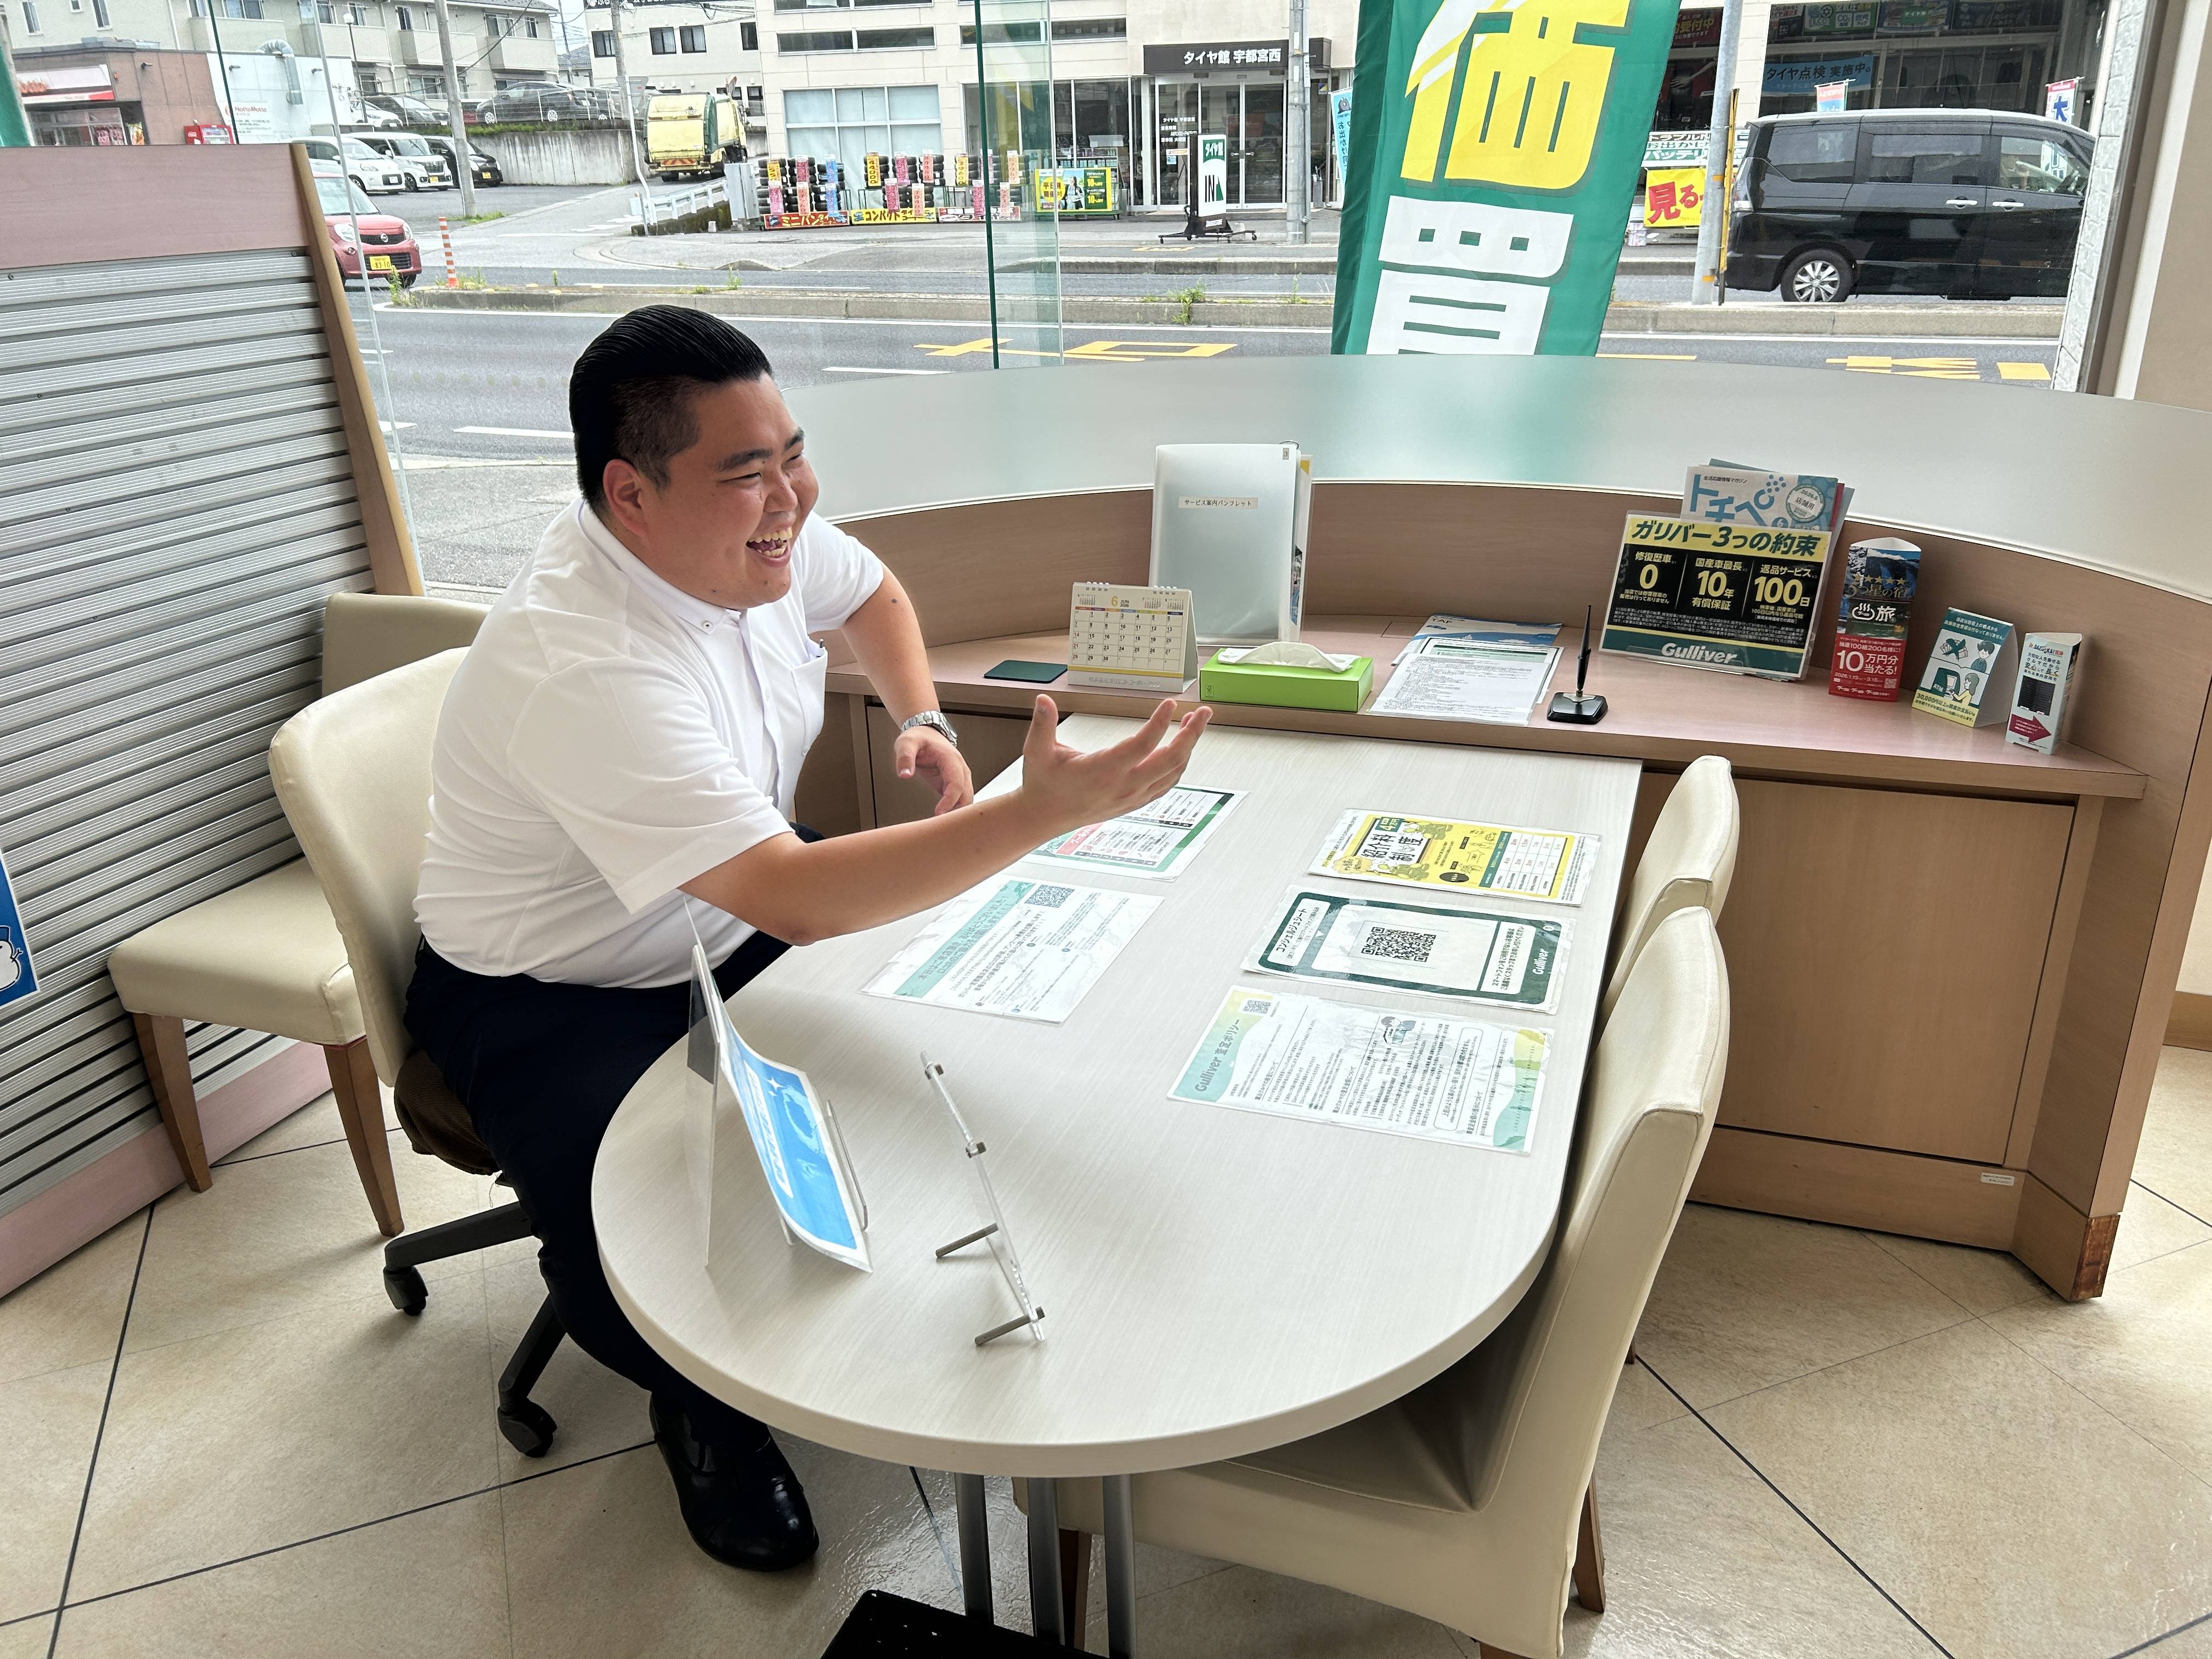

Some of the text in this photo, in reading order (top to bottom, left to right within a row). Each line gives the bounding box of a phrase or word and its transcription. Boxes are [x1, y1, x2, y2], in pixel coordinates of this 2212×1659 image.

[1676, 18, 1714, 33] 受付中
[1184, 48, 1282, 65] タイヤ館 宇都宮西
[1767, 65, 1826, 81] タイヤ点検
[1205, 174, 1215, 202] IN
[1647, 182, 1704, 224] 見る
[782, 215, 820, 227] ミニバン
[1795, 496, 1815, 510] 店舗用
[1801, 489, 1819, 501] 2026.6
[1632, 520, 1821, 556] ガリバー3つの約束
[1635, 551, 1672, 563] 修復歴車
[1695, 558, 1742, 571] 国産車最長
[1639, 564, 1658, 589] 0
[1760, 564, 1811, 577] 返品サービス
[1698, 571, 1734, 599] 10年
[1754, 576, 1810, 607] 100日
[1111, 596, 1118, 607] 6
[1692, 597, 1730, 611] 有償保証
[1875, 605, 1896, 622] 旅
[1661, 642, 1737, 664] Gulliver
[1837, 650, 1899, 672] 10 万円分
[1933, 684, 1943, 692] ATM
[1360, 833, 1397, 859] 紹介料
[1387, 836, 1423, 861] 制度
[1275, 908, 1308, 952] コンシェルジュシート
[1530, 947, 1550, 975] Gulliver
[1192, 1018, 1245, 1092] Gulliver 査定ポリシー
